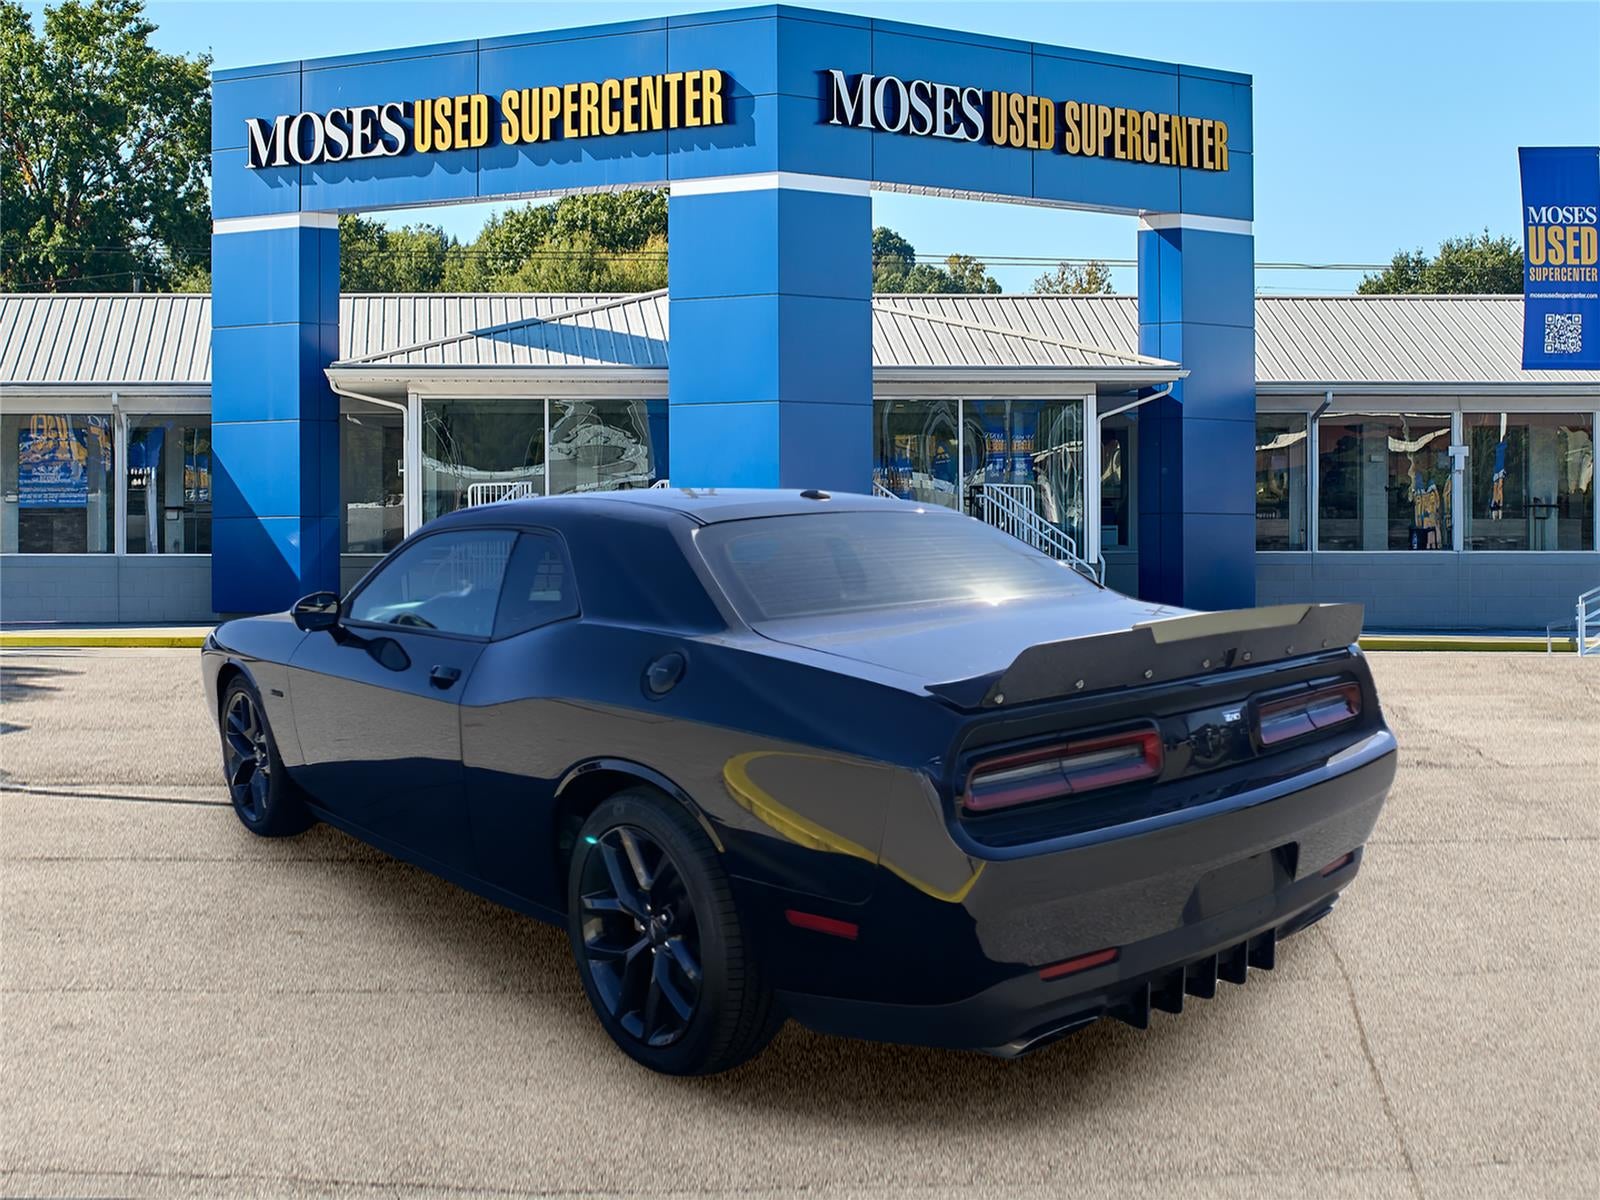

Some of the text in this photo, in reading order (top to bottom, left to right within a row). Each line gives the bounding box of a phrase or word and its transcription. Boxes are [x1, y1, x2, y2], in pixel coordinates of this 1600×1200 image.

[244, 69, 724, 169] MOSES USED SUPERCENTER
[828, 69, 1229, 171] MOSES USED SUPERCENTER
[1527, 206, 1597, 225] MOSES
[1528, 225, 1598, 266] USED
[1529, 267, 1598, 282] SUPERCENTER
